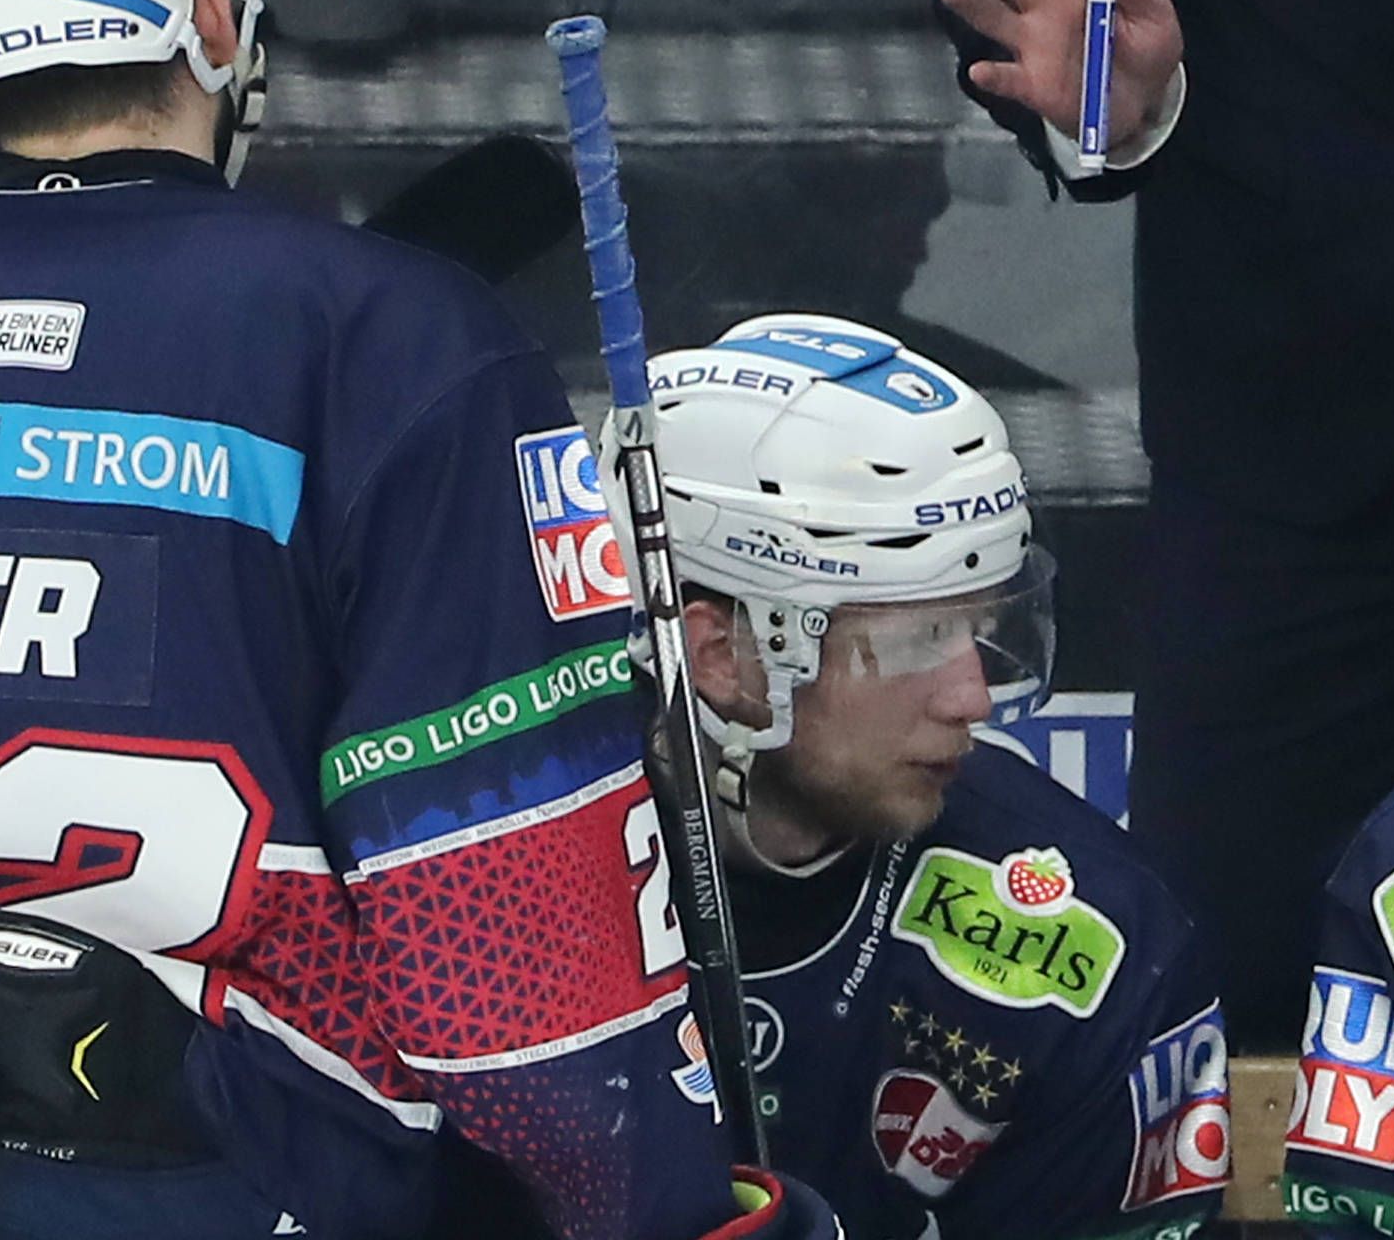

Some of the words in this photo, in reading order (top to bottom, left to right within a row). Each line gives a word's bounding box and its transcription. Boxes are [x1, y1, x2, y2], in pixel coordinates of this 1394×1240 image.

[8, 312, 41, 331] BIN
[42, 314, 74, 334] EIN
[648, 365, 795, 397] ADLER
[16, 427, 231, 501] STROM
[914, 476, 1029, 527] STADL
[725, 534, 860, 578] STADLER
[333, 734, 415, 787] LIGO
[427, 693, 519, 754] LIGO
[683, 808, 717, 921] BERGMANN
[912, 872, 1096, 994] Karls
[973, 956, 1009, 986] 1921
